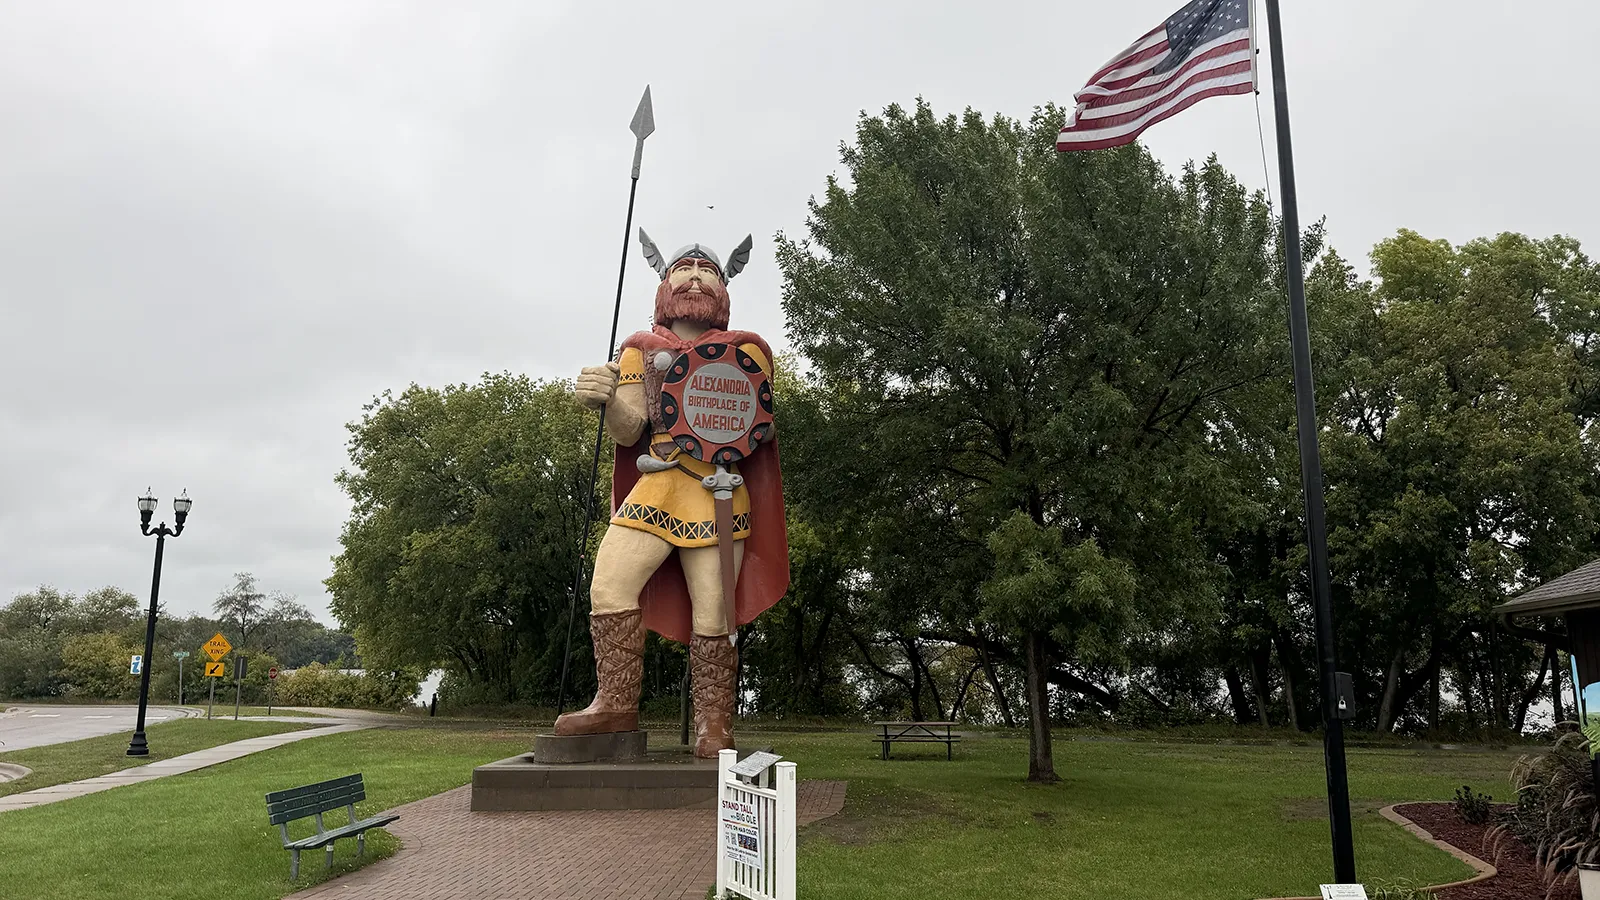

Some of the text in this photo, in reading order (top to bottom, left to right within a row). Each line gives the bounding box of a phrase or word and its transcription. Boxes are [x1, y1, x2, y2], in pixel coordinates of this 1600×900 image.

[690, 374, 751, 396] ALEXANDRIA
[688, 395, 751, 412] BIRTHPLACE OF
[692, 413, 746, 432] AMERICA
[722, 800, 753, 814] STAND TALL
[736, 812, 745, 822] BIG
[746, 814, 756, 825] OLE
